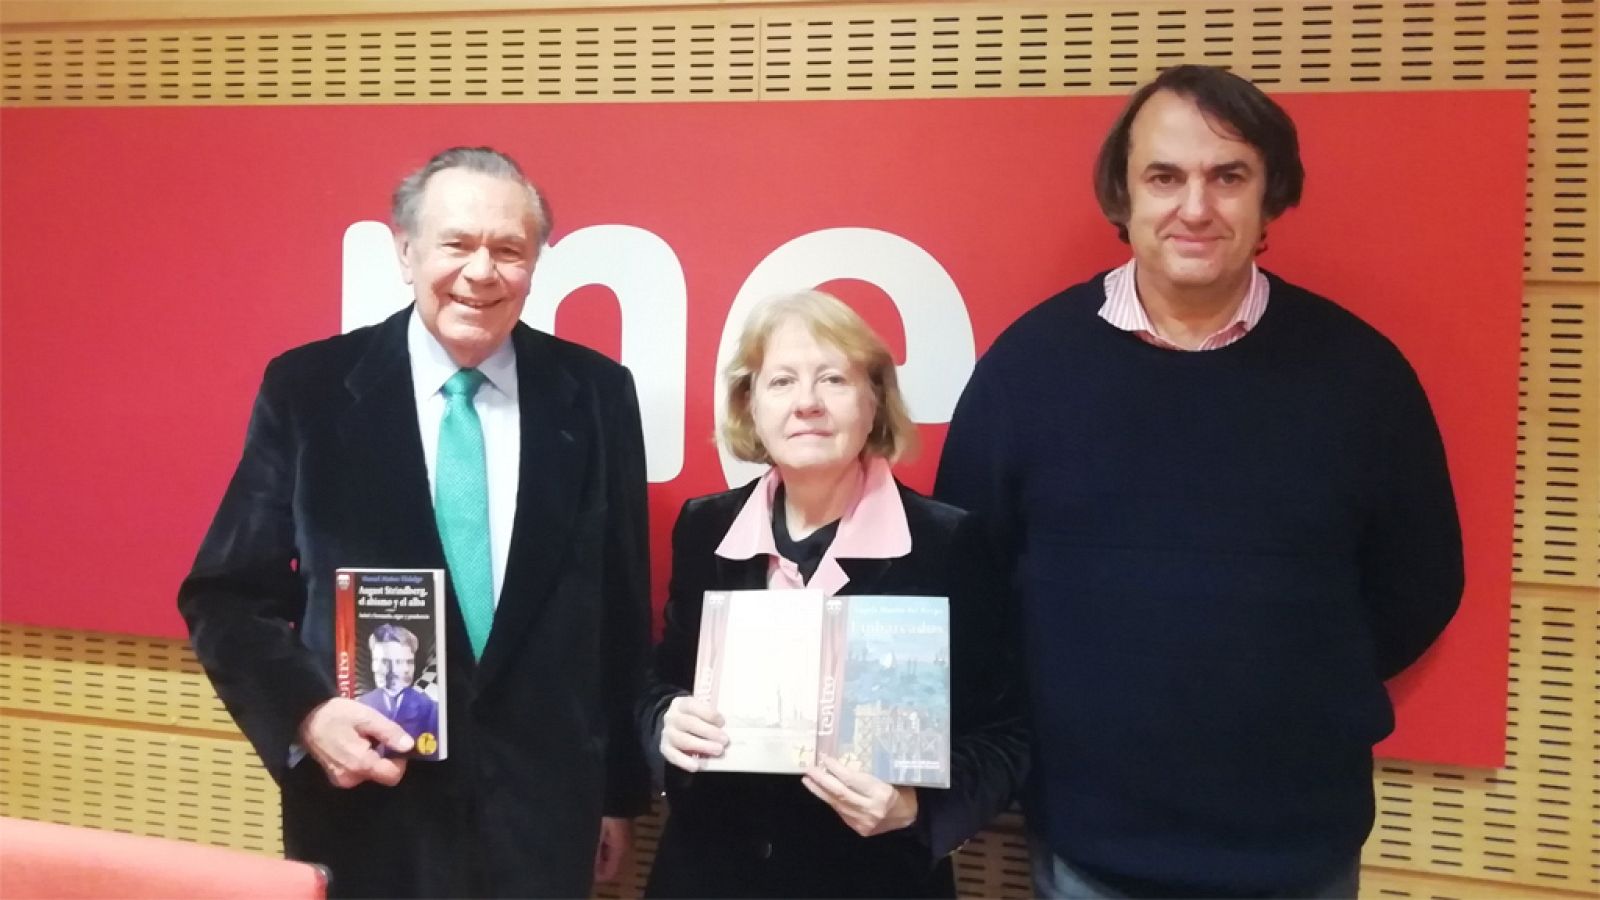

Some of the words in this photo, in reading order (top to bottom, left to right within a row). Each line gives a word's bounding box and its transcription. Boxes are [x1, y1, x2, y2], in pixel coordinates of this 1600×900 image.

[358, 585, 384, 599] August
[385, 585, 429, 598] Strindberg,
[358, 596, 366, 606] el
[399, 596, 408, 607] el
[408, 596, 426, 607] alba
[338, 650, 350, 700] eatro
